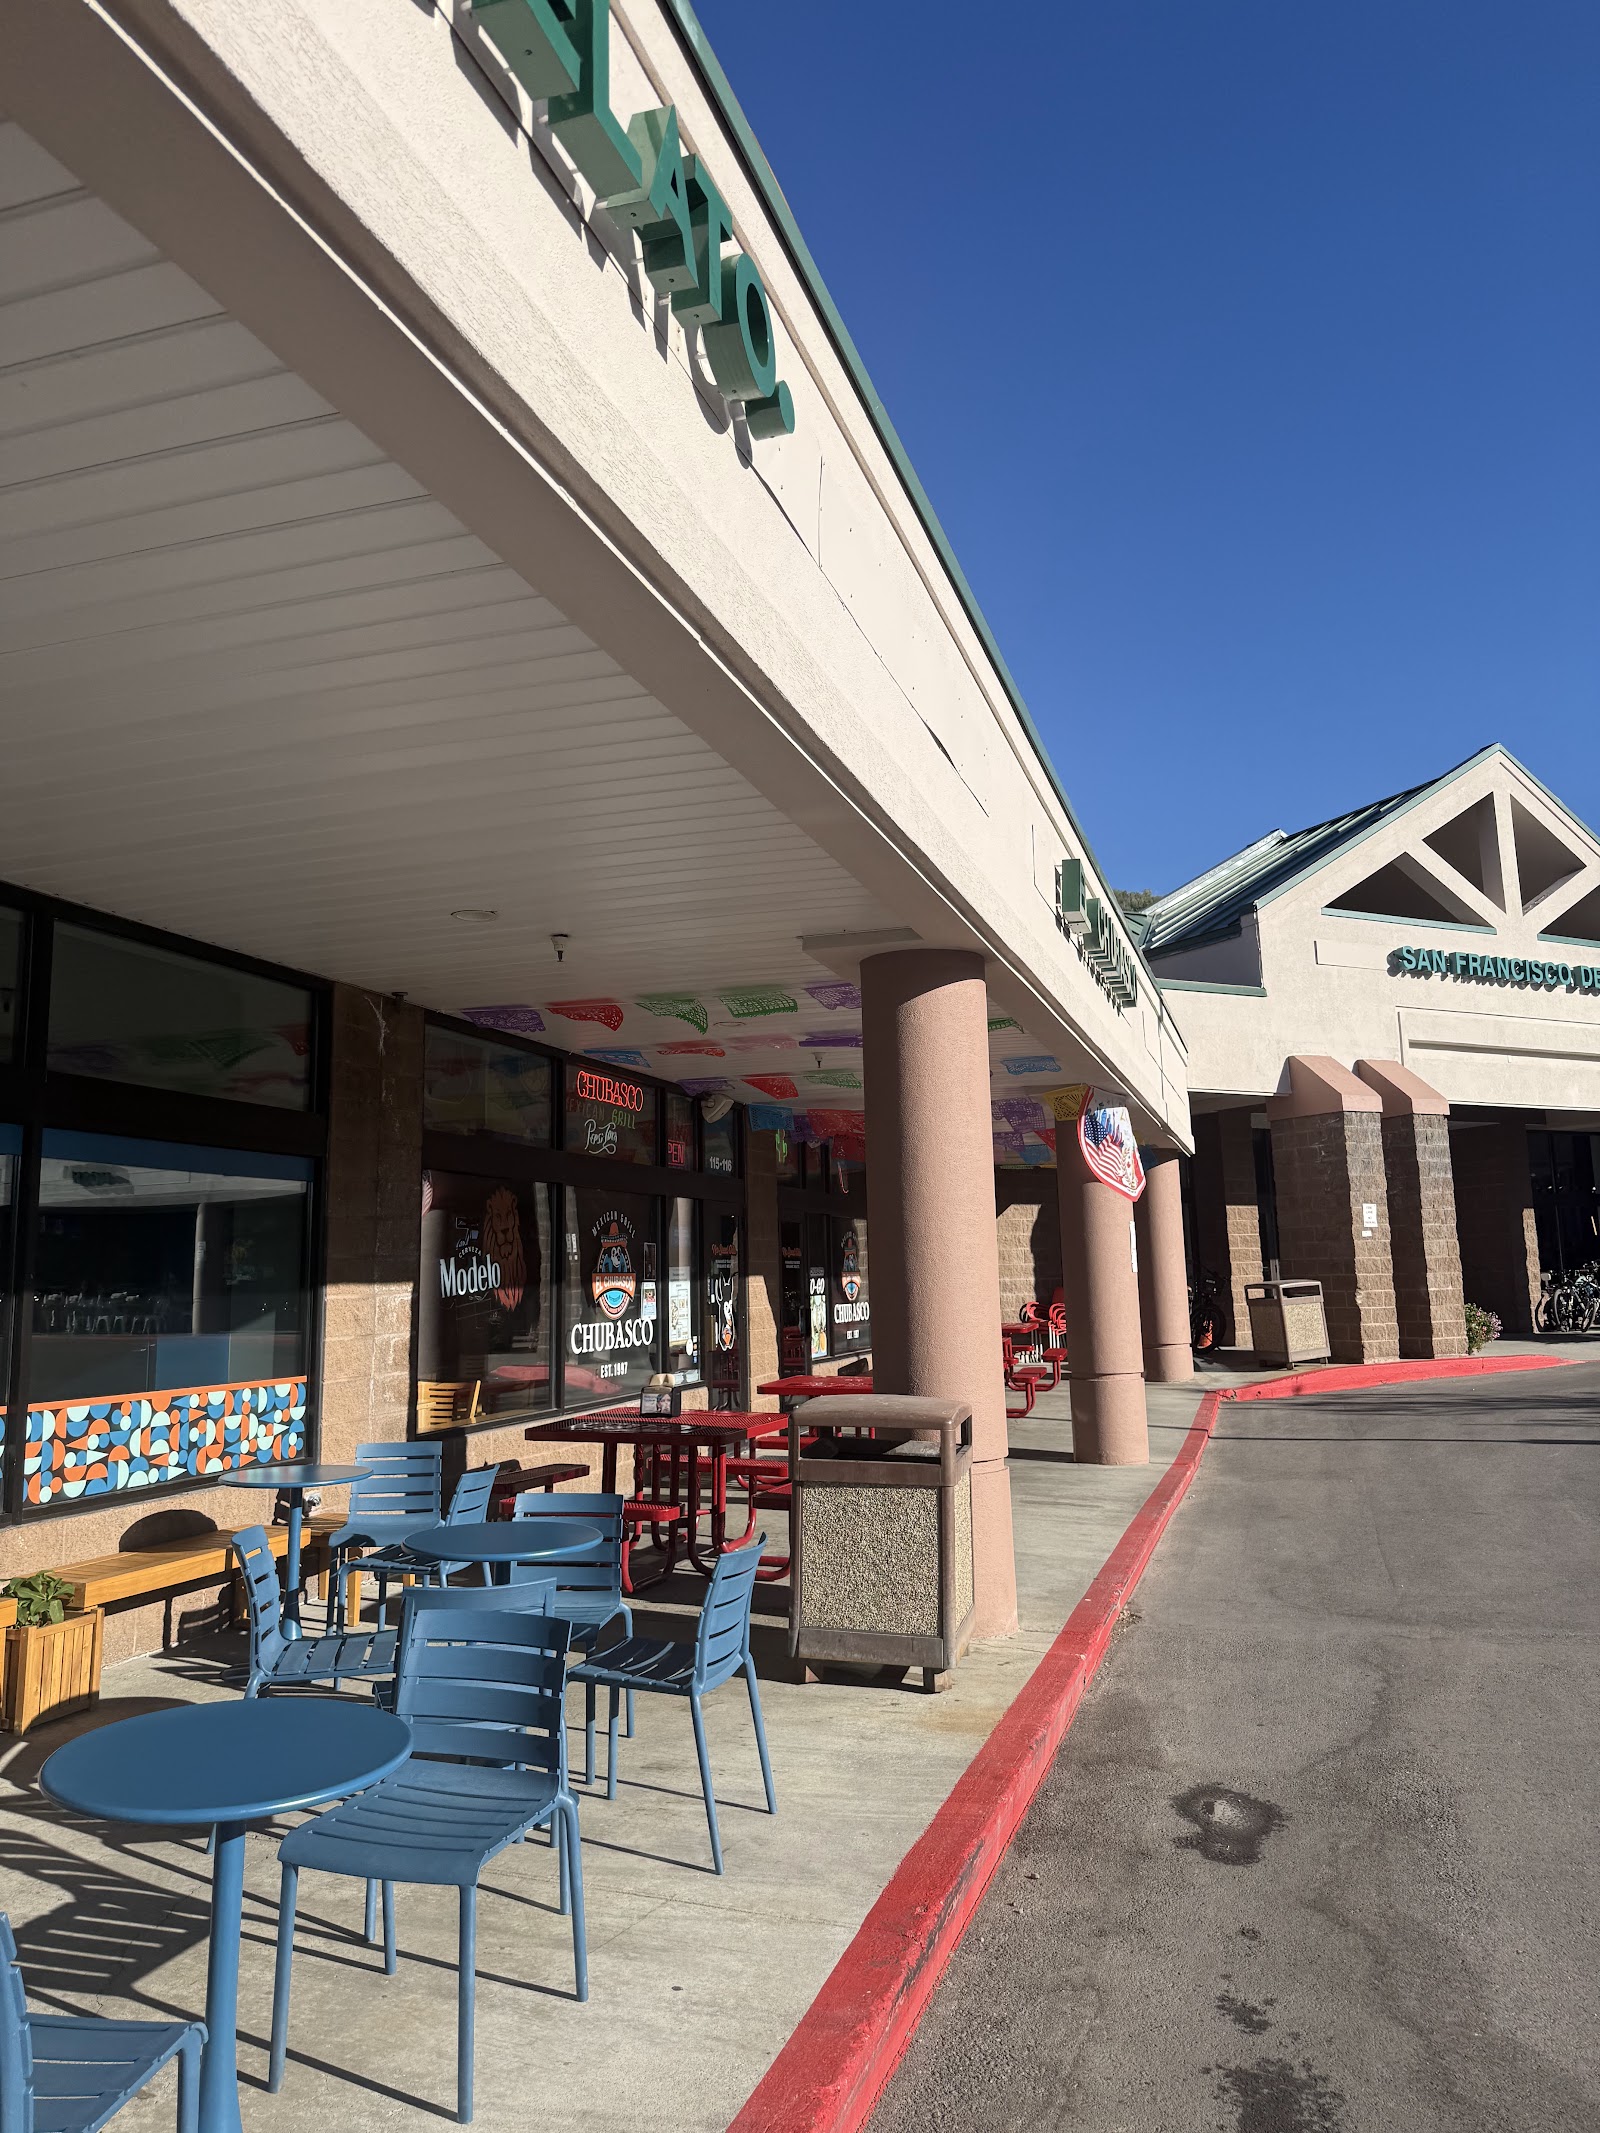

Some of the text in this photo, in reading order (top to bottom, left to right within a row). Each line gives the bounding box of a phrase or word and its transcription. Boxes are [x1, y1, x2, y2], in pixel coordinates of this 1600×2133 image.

[1402, 945, 1447, 973] SAN
[1455, 951, 1572, 986] FRANCISCO
[576, 1070, 645, 1112] CHUBASCO
[611, 1108, 636, 1130] GRILL
[667, 1141, 685, 1165] PEN
[591, 1210, 636, 1239] MEXICAN GRILL
[458, 1246, 482, 1259] CERVEZA
[439, 1253, 501, 1298] Modelo
[595, 1275, 634, 1294] EL CHUBASCO
[834, 1301, 870, 1324] CHUBASCO
[570, 1317, 654, 1355] CHUBASCO
